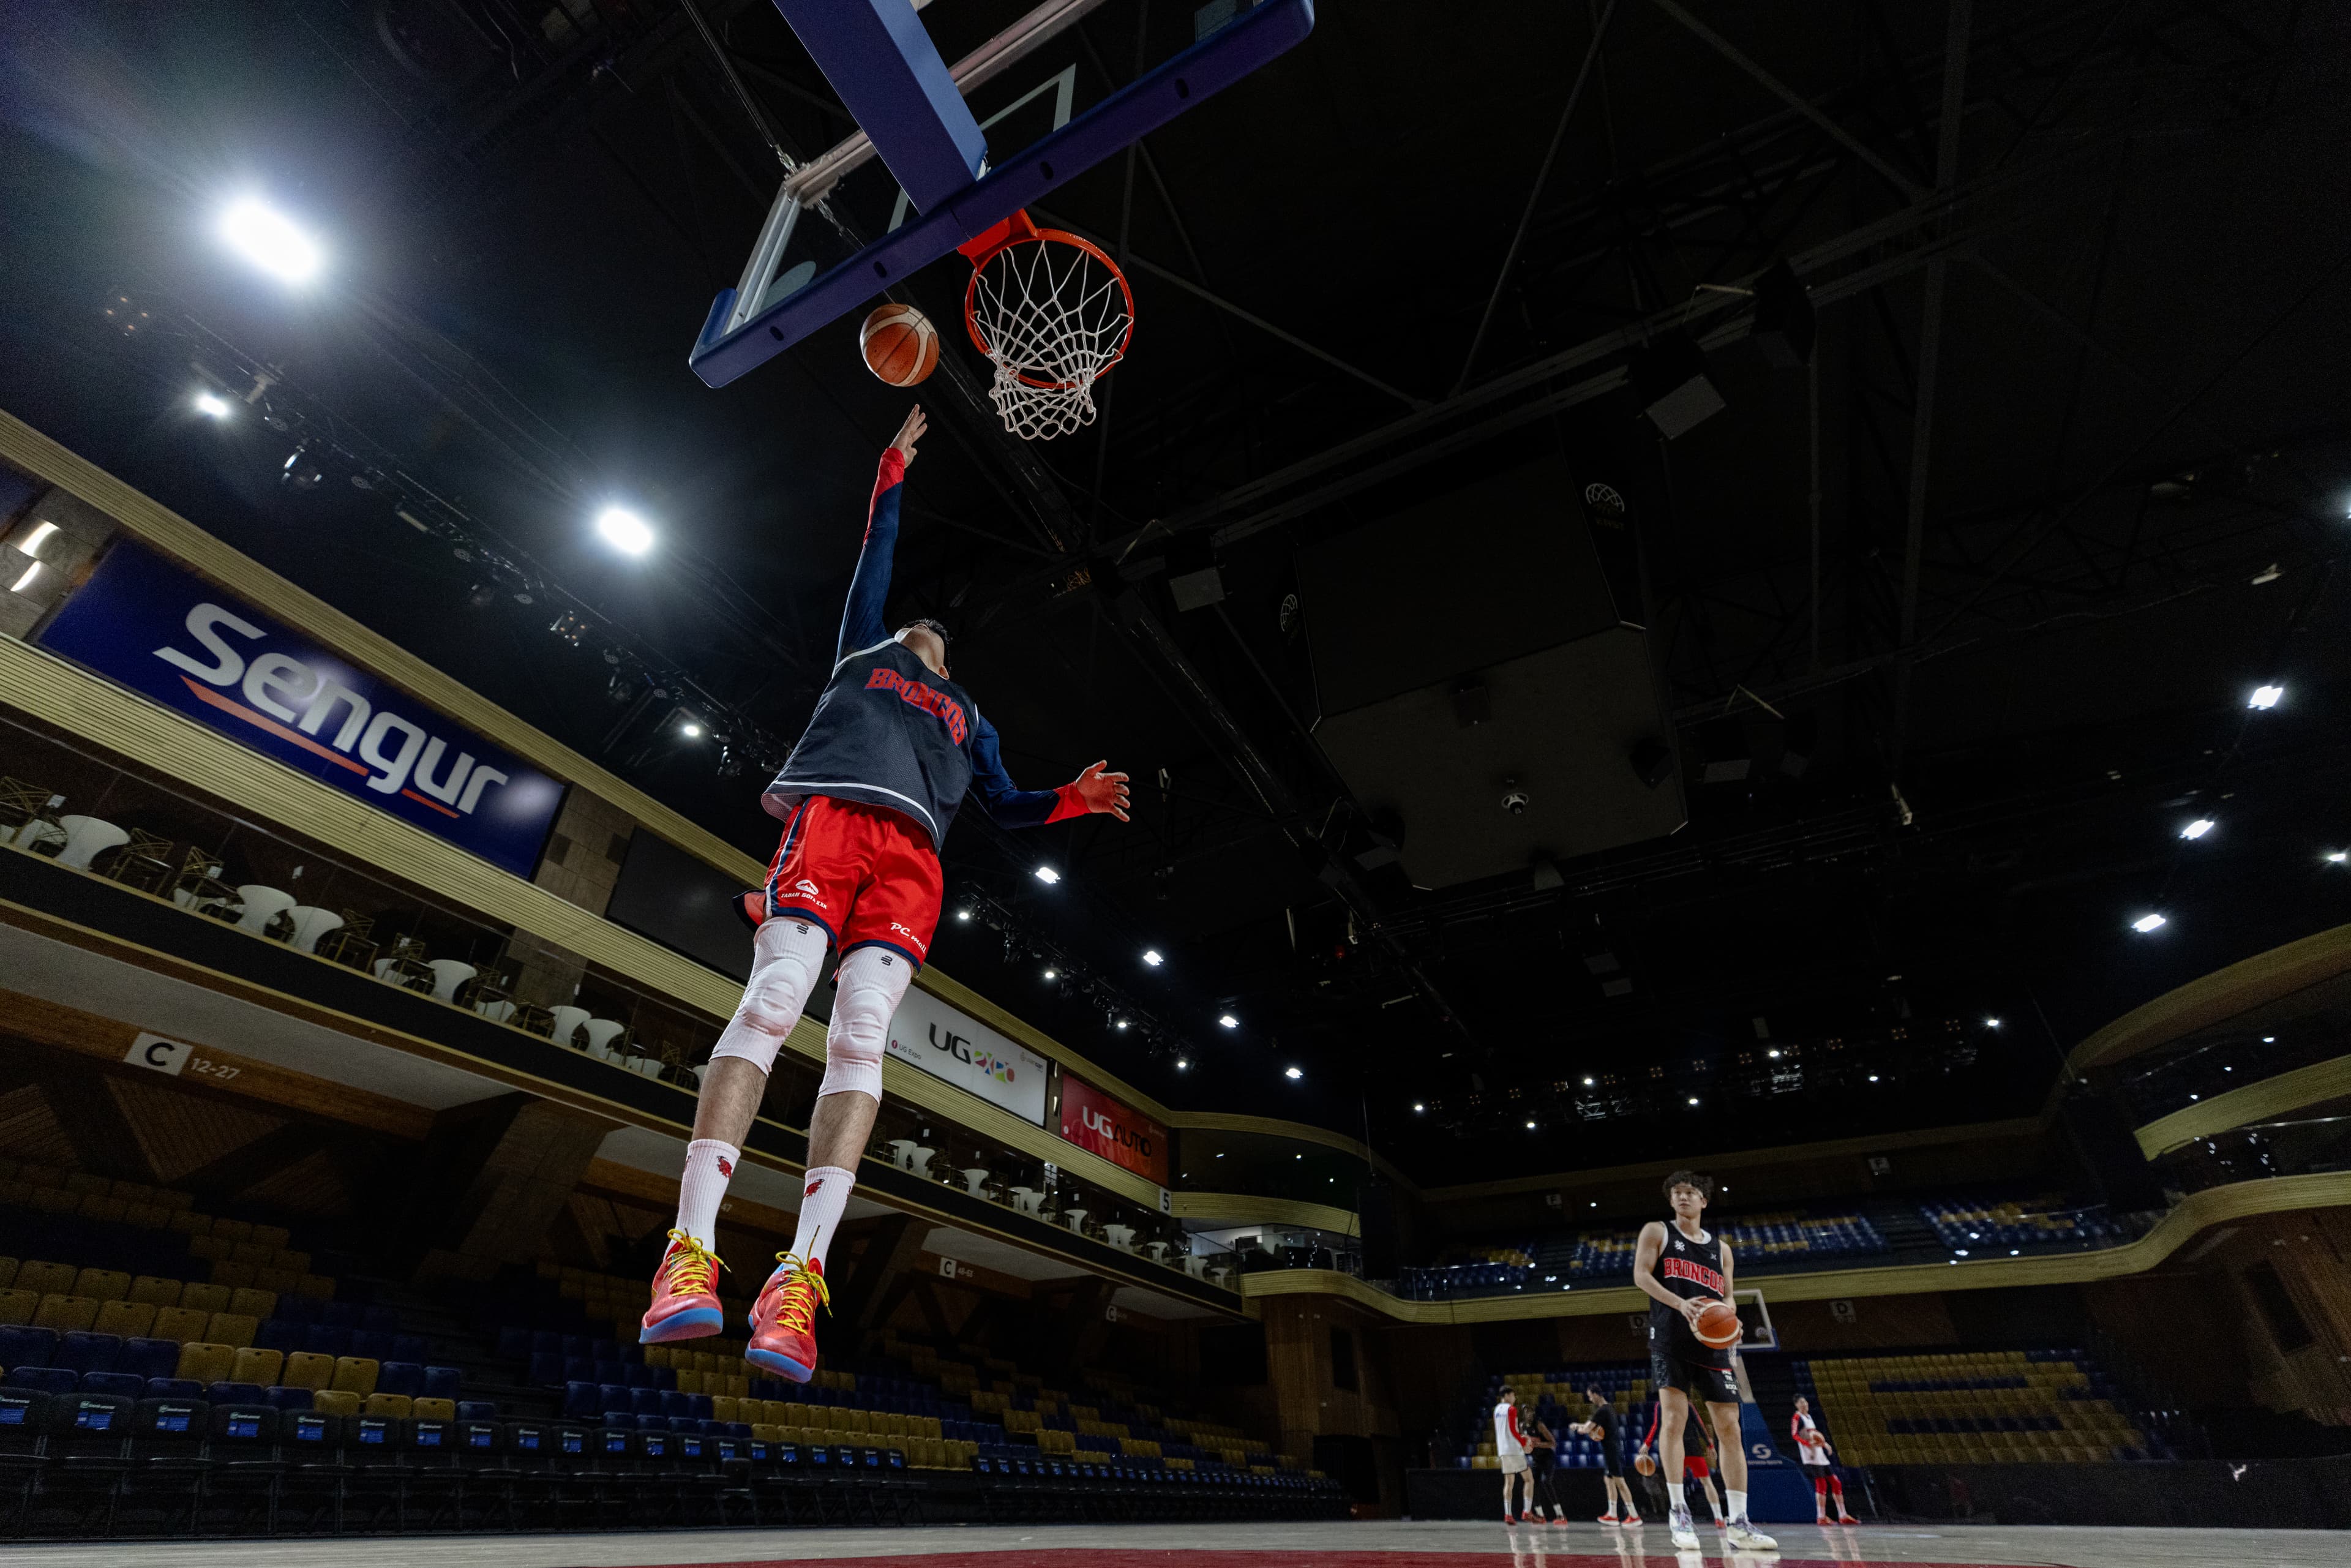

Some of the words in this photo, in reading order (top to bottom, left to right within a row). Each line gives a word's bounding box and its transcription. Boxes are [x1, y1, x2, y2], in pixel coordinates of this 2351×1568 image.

[152, 602, 508, 815] Sengur
[864, 667, 966, 746] BRONCOS
[890, 922, 910, 937] PC
[911, 936, 926, 954] mall
[899, 1045, 907, 1053] UG
[908, 1048, 921, 1060] Expo
[929, 1022, 971, 1065] UG
[145, 1042, 174, 1066] C
[191, 1057, 241, 1081] 12-27
[1163, 1192, 1169, 1211] 5
[944, 1261, 951, 1275] C
[1663, 1257, 1725, 1297] BRONCOS
[1837, 1303, 1848, 1314] D
